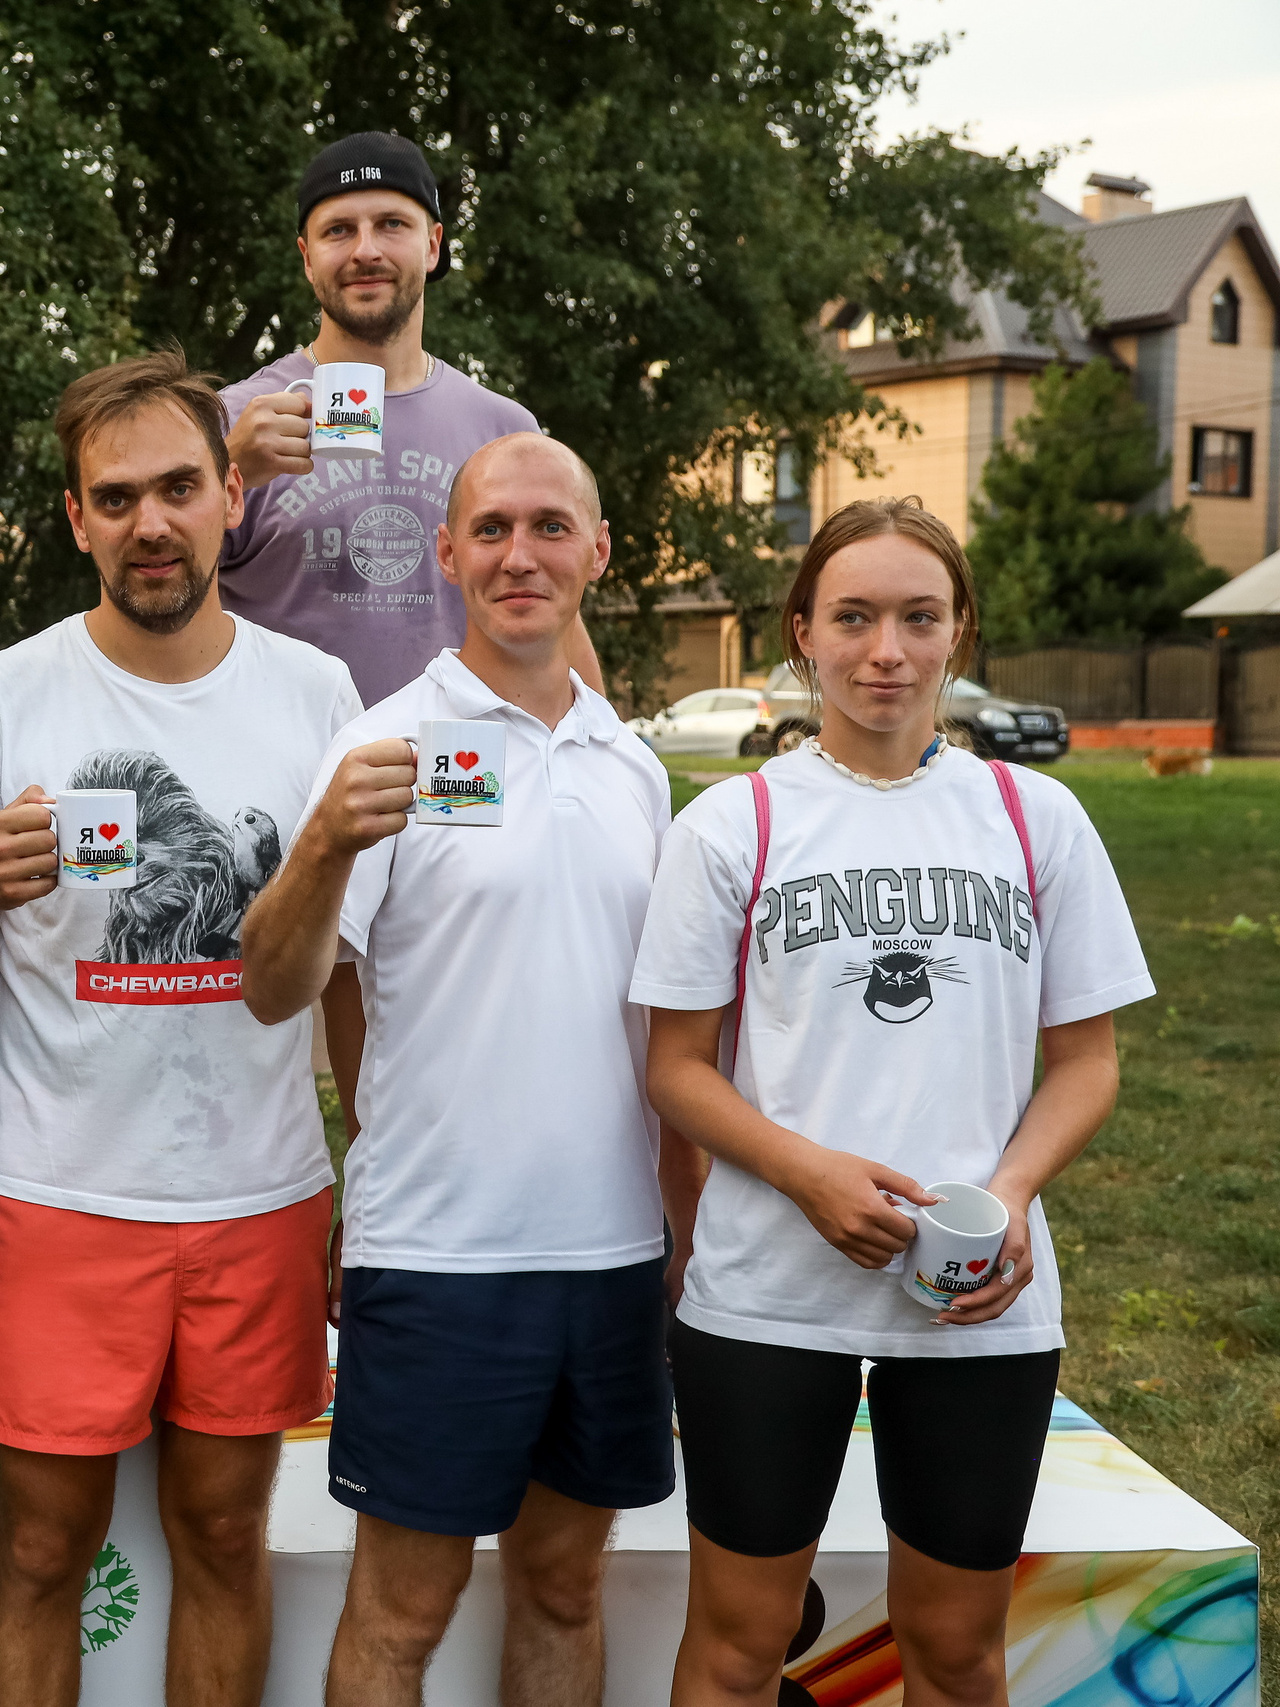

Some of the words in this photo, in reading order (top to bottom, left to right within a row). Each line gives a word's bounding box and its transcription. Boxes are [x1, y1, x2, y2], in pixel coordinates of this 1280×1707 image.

[340, 169, 357, 184] EST.
[331, 392, 344, 407] Я
[329, 411, 372, 424] ПОТАПОВО
[276, 449, 386, 518] BRAVE
[399, 449, 453, 493] SPI
[319, 486, 374, 515] SUPERIOR
[377, 485, 416, 497] URBAN
[420, 489, 448, 511] BRAN
[362, 509, 415, 528] CHALLENGE
[332, 592, 381, 603] SPECIAL
[386, 593, 434, 604] EDITION
[434, 755, 449, 773] Я
[433, 780, 485, 793] ПОТАПОВО
[80, 827, 94, 844] Я
[79, 849, 126, 860] ПОТАПОВО
[755, 867, 1033, 965] PENGUINS
[872, 939, 933, 951] MOSCOW
[89, 972, 243, 994] CHEWBAC
[942, 1260, 962, 1276] Я
